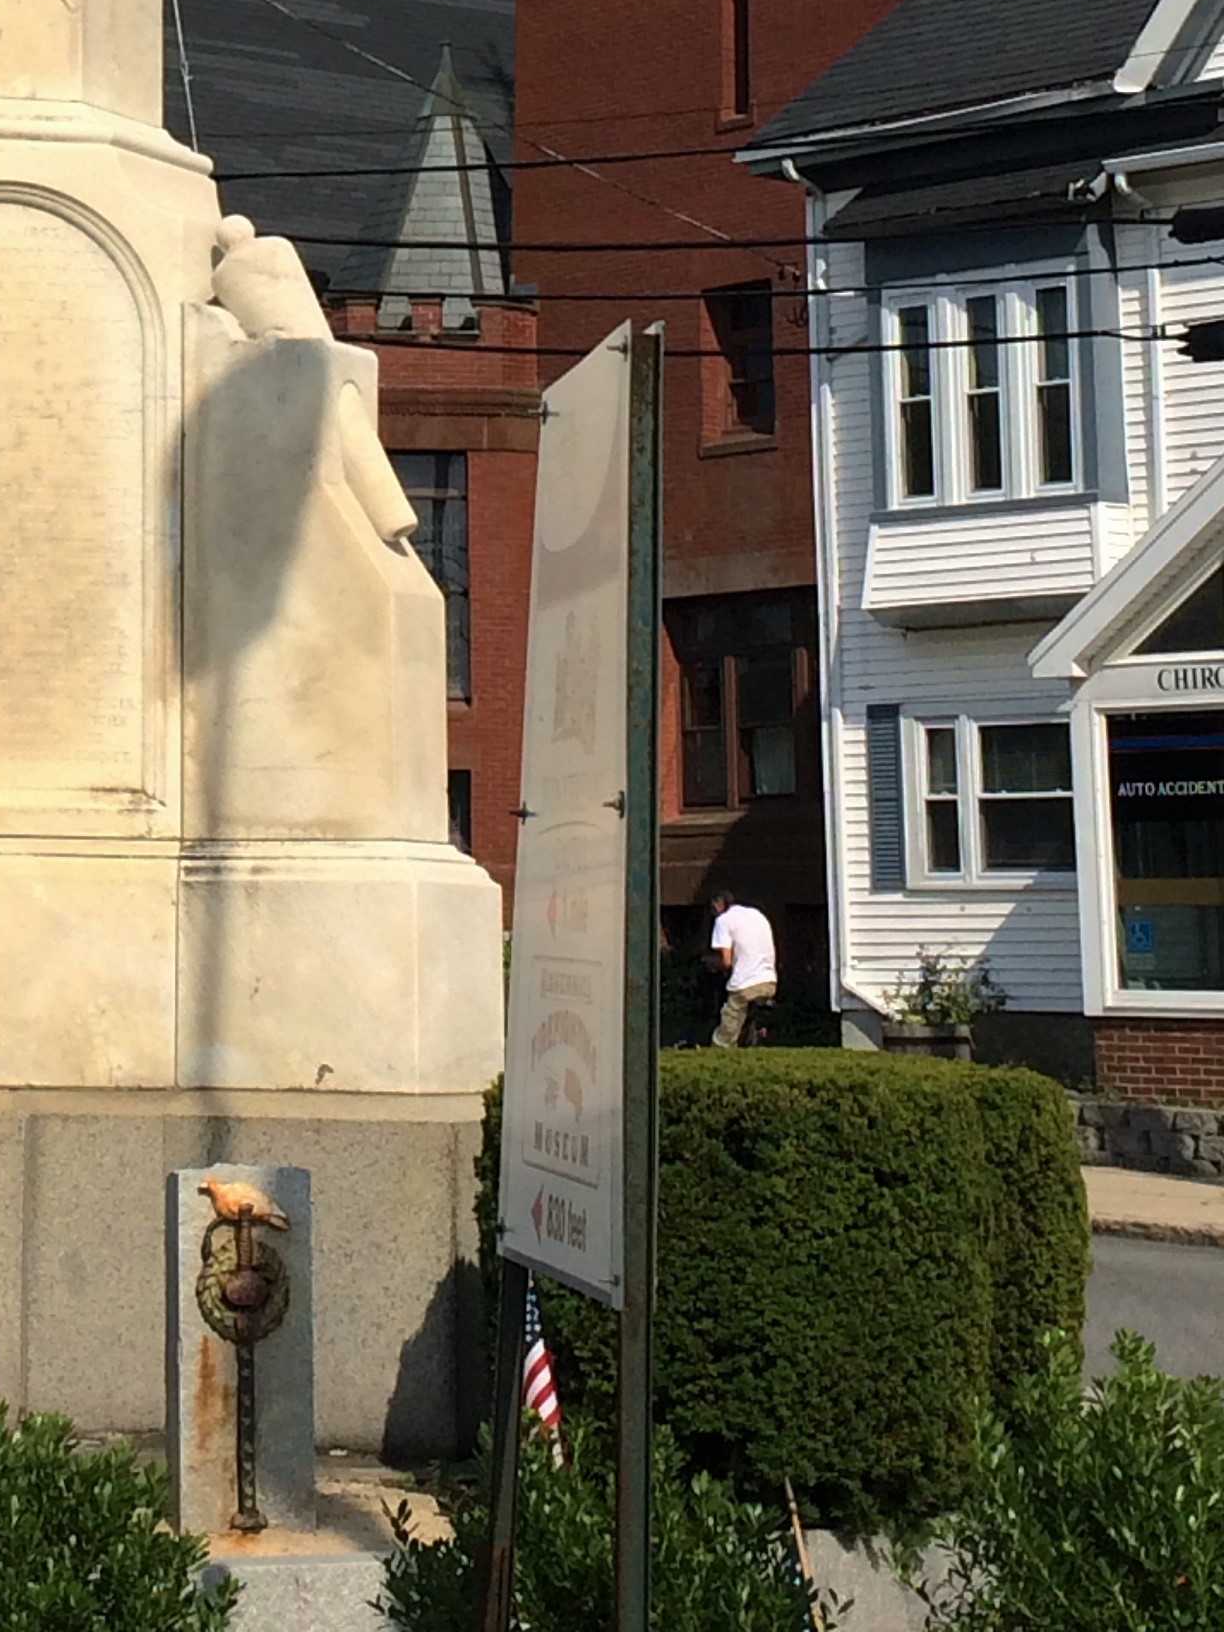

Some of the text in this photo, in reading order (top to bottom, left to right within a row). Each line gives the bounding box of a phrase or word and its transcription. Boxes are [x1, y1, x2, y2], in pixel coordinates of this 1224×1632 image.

[1117, 779, 1224, 797] AUTO ACCIDENT
[533, 1119, 589, 1167] MUSEUM
[568, 1200, 587, 1252] feet
